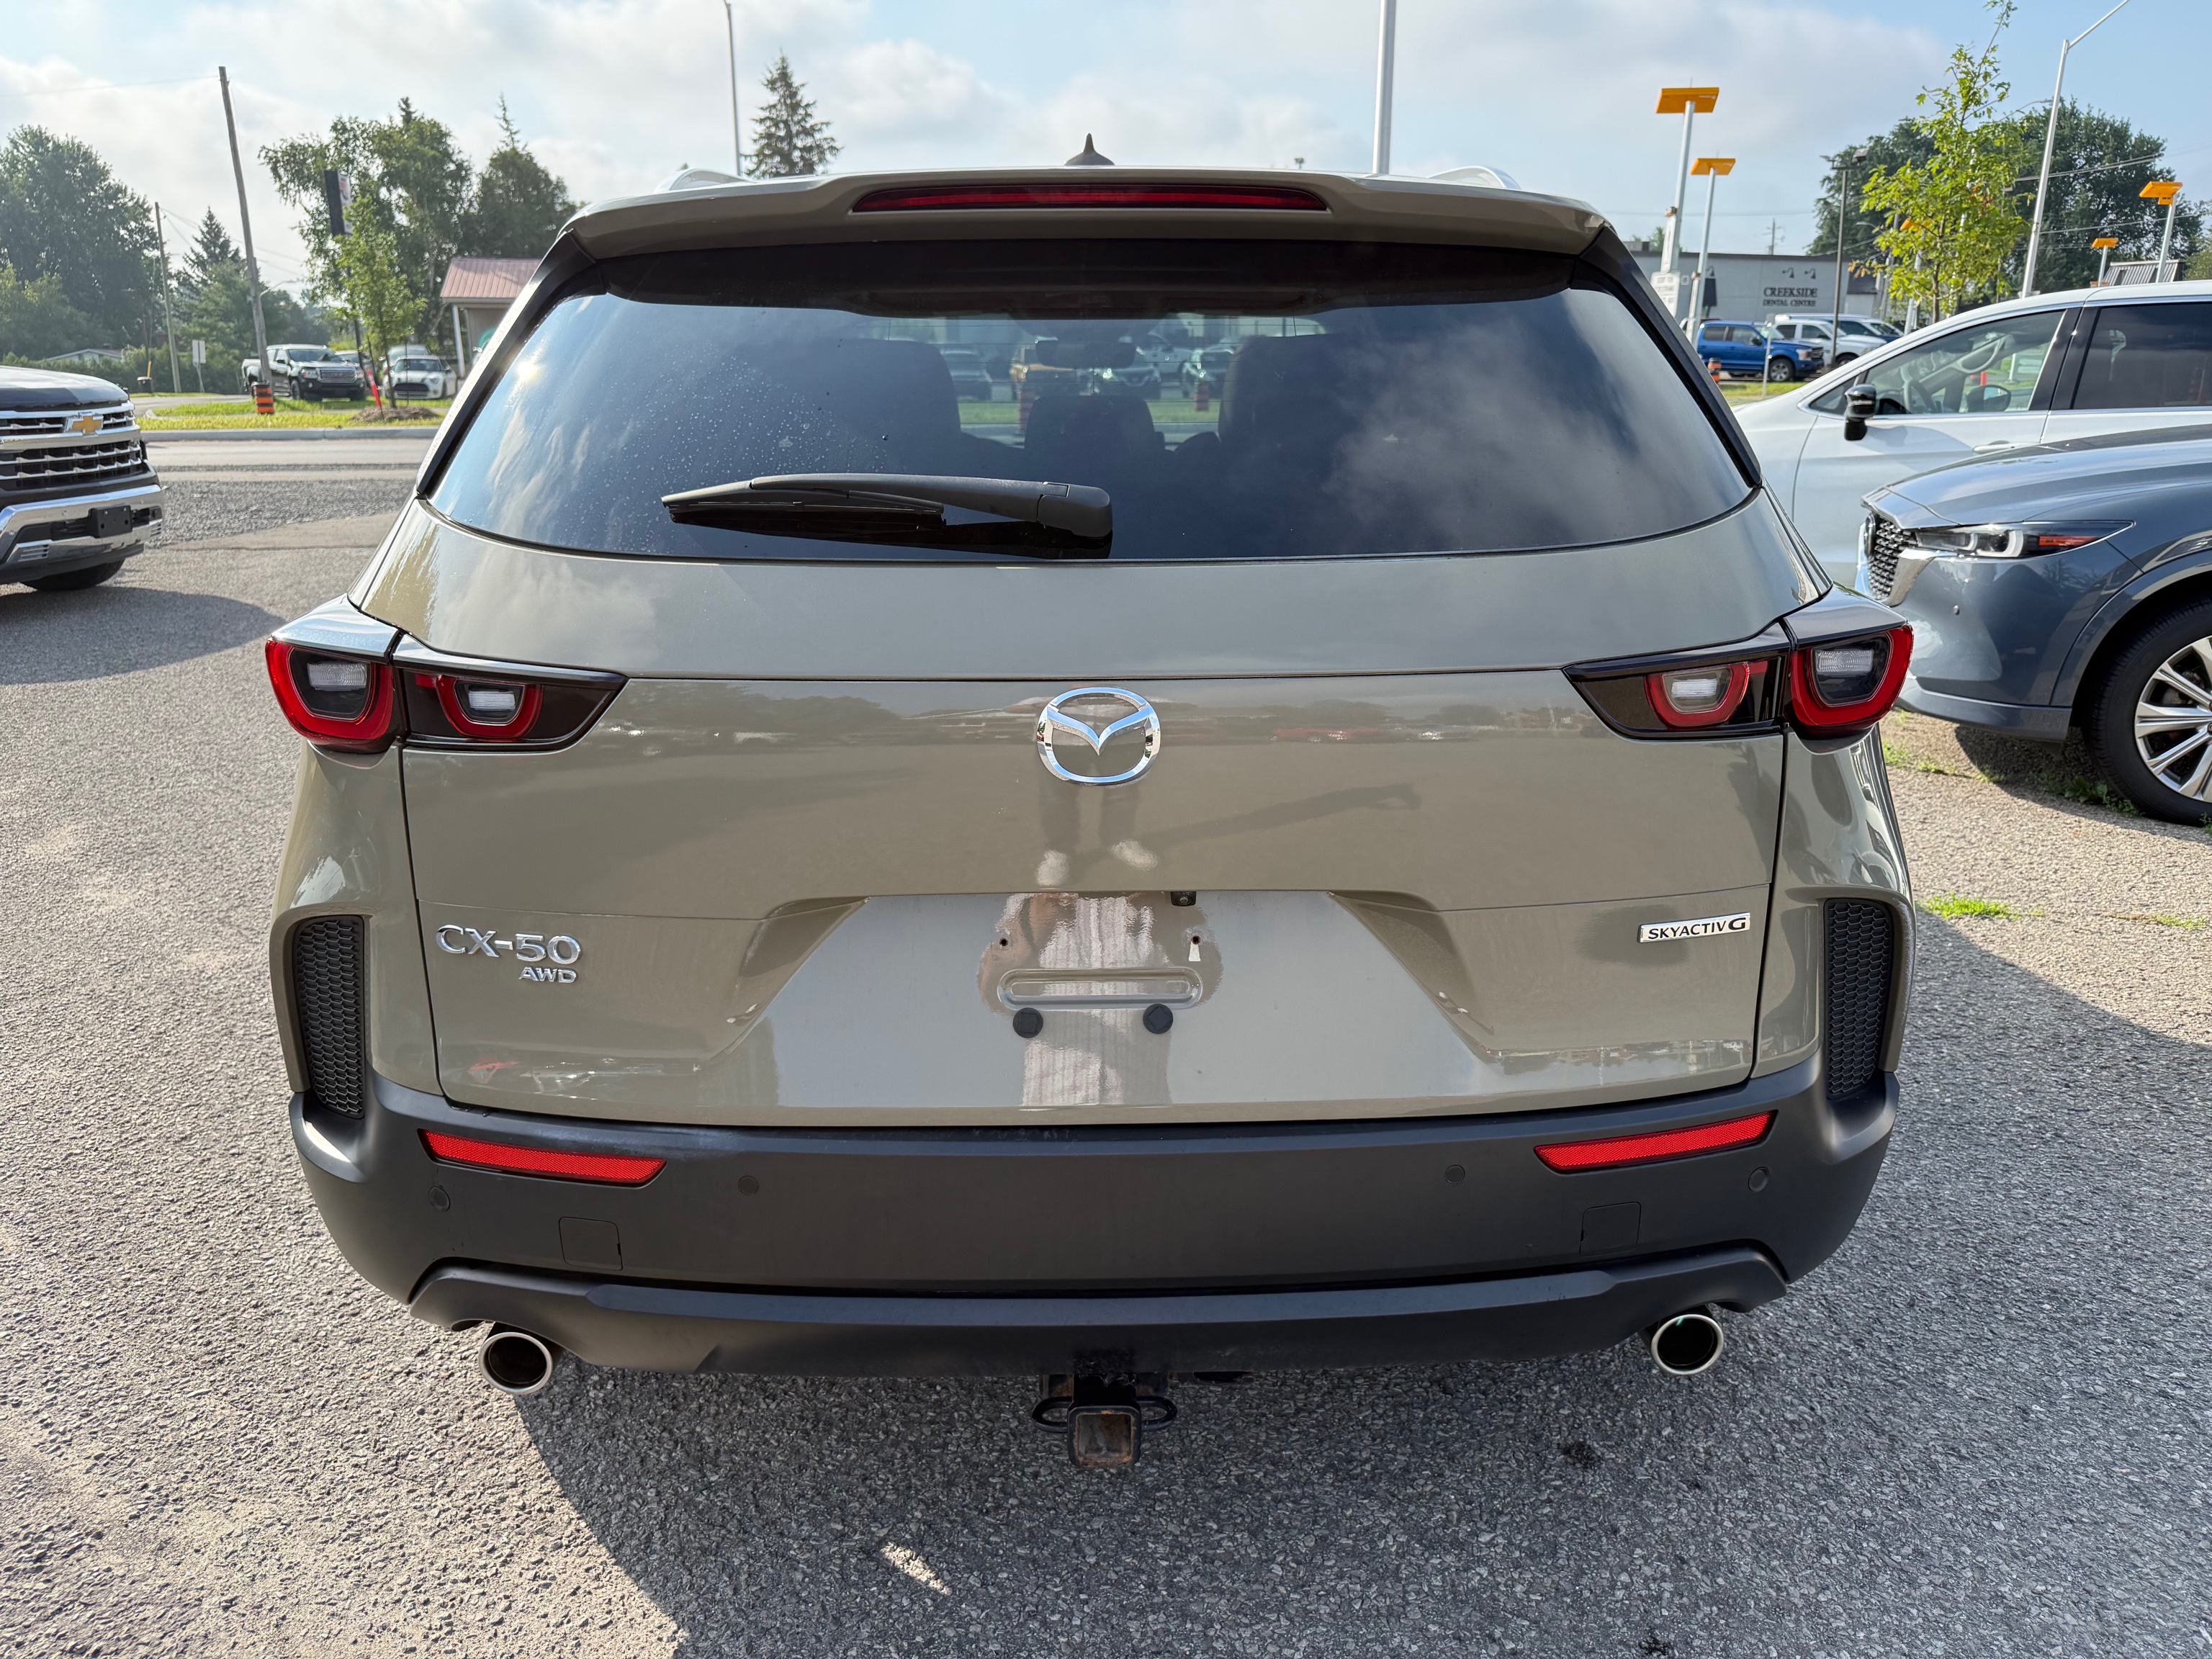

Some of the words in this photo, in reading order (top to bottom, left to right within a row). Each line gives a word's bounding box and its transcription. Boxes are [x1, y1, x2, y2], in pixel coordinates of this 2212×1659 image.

[1763, 287, 1818, 297] CREEKSIDE
[436, 925, 581, 965] CX-50
[518, 966, 577, 984] AWD
